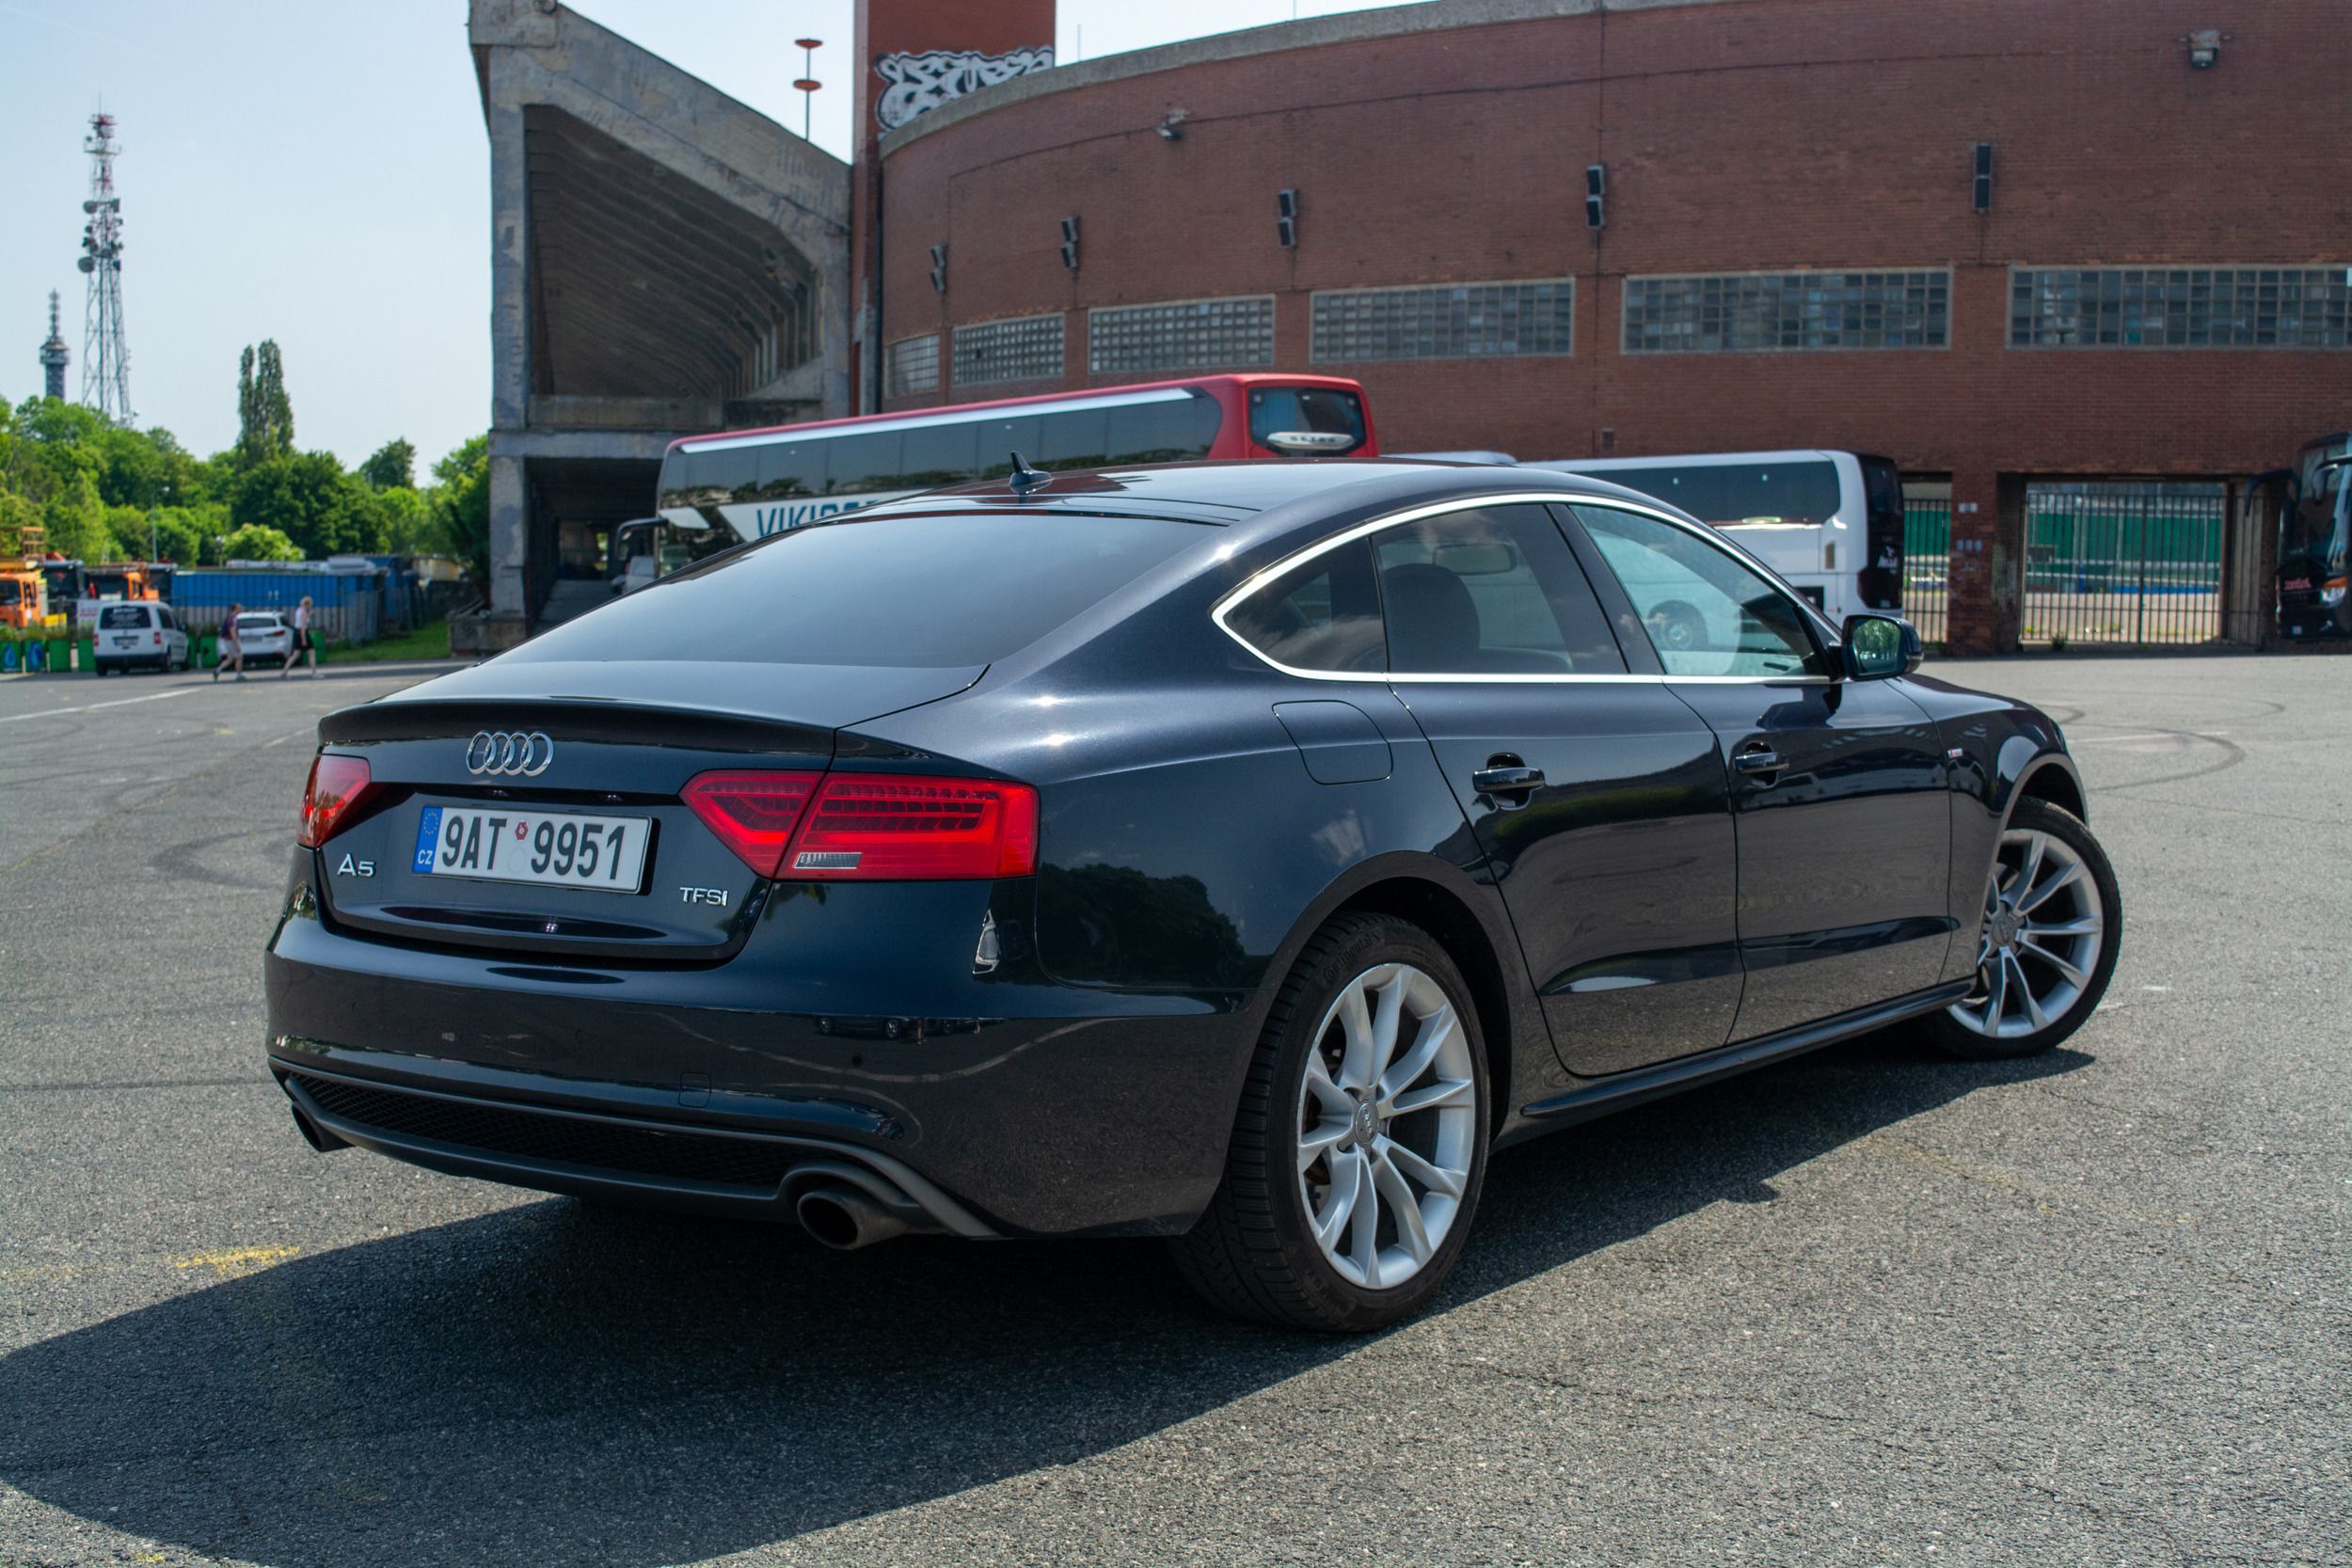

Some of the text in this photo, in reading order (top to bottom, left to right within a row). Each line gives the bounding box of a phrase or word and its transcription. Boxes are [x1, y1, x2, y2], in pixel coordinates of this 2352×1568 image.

[417, 849, 433, 865] CZ
[442, 816, 626, 880] 9AT 9951
[337, 853, 375, 877] A5
[679, 887, 728, 907] TFSI
